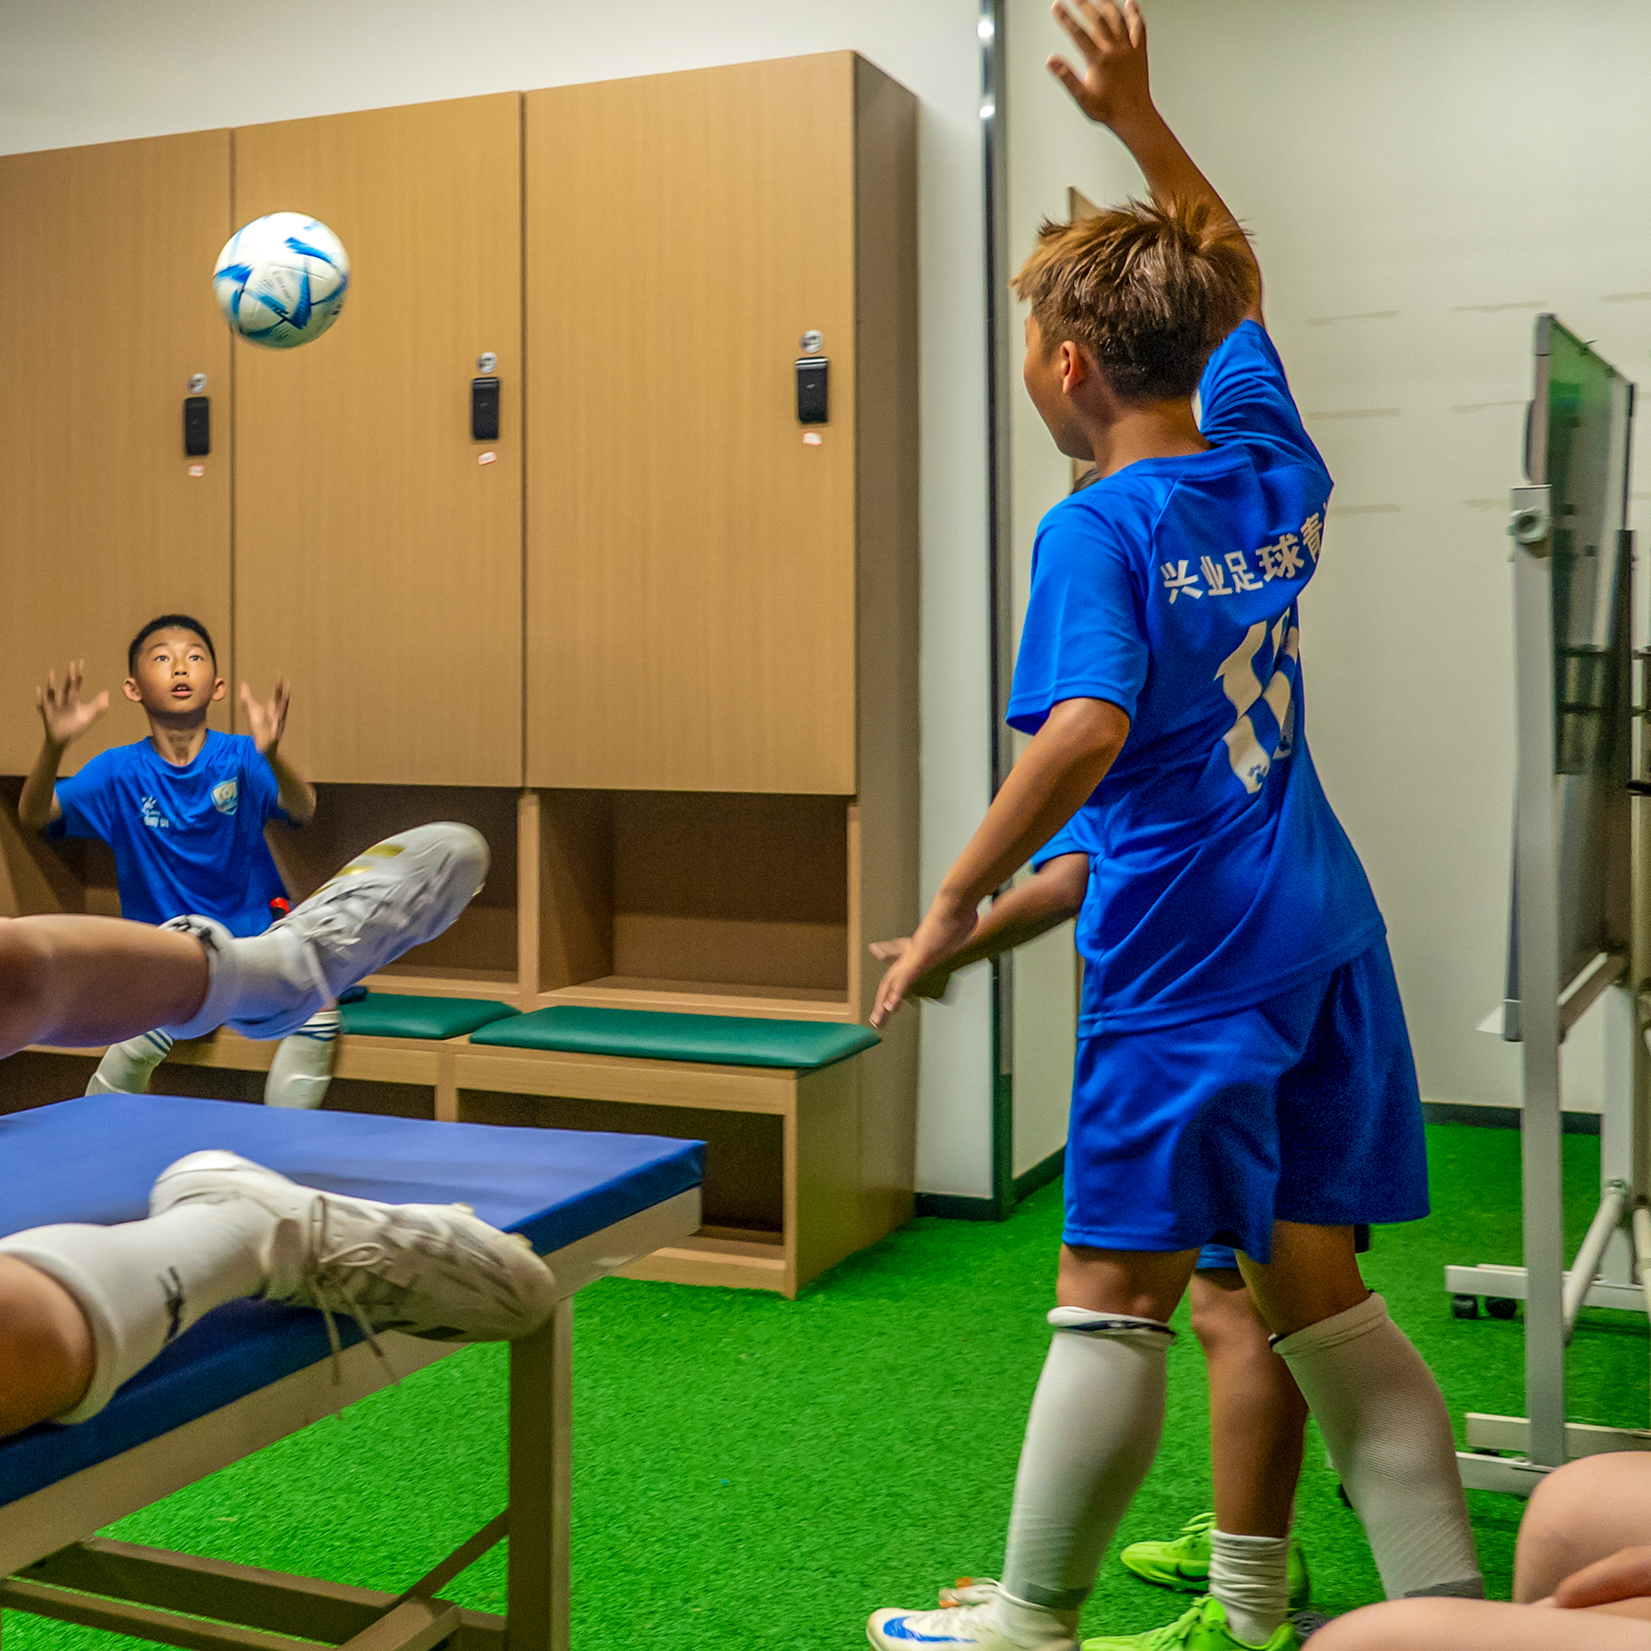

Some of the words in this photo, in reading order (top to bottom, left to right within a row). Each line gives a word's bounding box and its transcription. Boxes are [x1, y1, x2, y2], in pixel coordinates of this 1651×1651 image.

[1160, 503, 1328, 605] 兴业足球青
